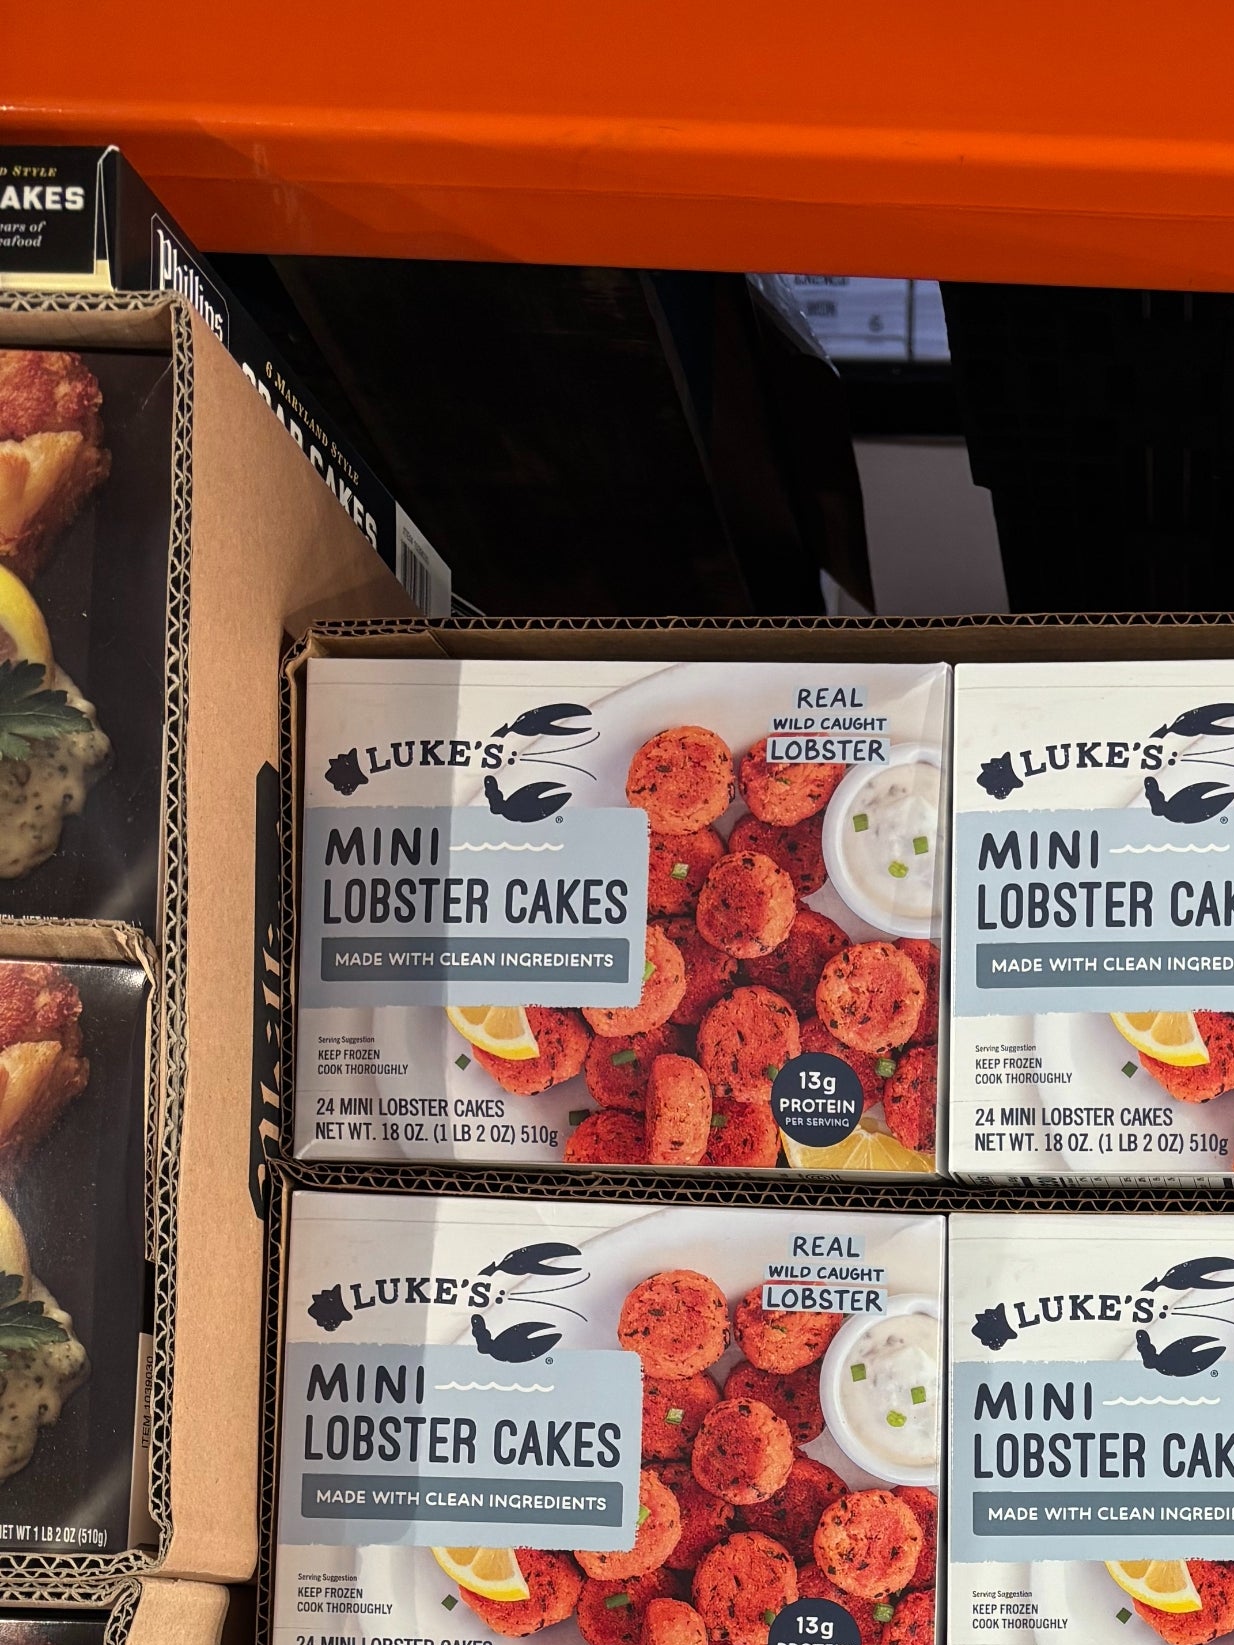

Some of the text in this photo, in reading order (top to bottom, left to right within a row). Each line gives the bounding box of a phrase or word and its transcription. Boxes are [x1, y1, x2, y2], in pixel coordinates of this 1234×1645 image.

[0, 185, 85, 210] AKES
[0, 220, 46, 232] ars of
[265, 361, 273, 379] 6
[274, 372, 329, 448] MARYLAND
[331, 441, 359, 486] STYLE
[324, 826, 440, 867] MINI
[978, 829, 1098, 871] MINI
[322, 877, 628, 925] LOBSTER CAKES
[977, 882, 1153, 929] LOBSTER
[334, 952, 614, 967] MADE WITH CLEAN INGREDIENTS
[304, 1361, 425, 1405] MINI
[974, 1381, 1092, 1421] MINI
[301, 1414, 622, 1469] LOBSTER CAKES
[974, 1433, 1146, 1478] LOBSTER
[16, 1525, 30, 1541] WT
[33, 1527, 38, 1541] 1
[41, 1526, 52, 1542] LB
[56, 1528, 61, 1542] 2
[64, 1528, 76, 1543] OZ
[78, 1528, 108, 1546] (510g)
[296, 1586, 364, 1598] KEEP FROZEN
[297, 1572, 358, 1583] Serving Suggestion
[296, 1600, 392, 1614] COOK THOROUGHLY
